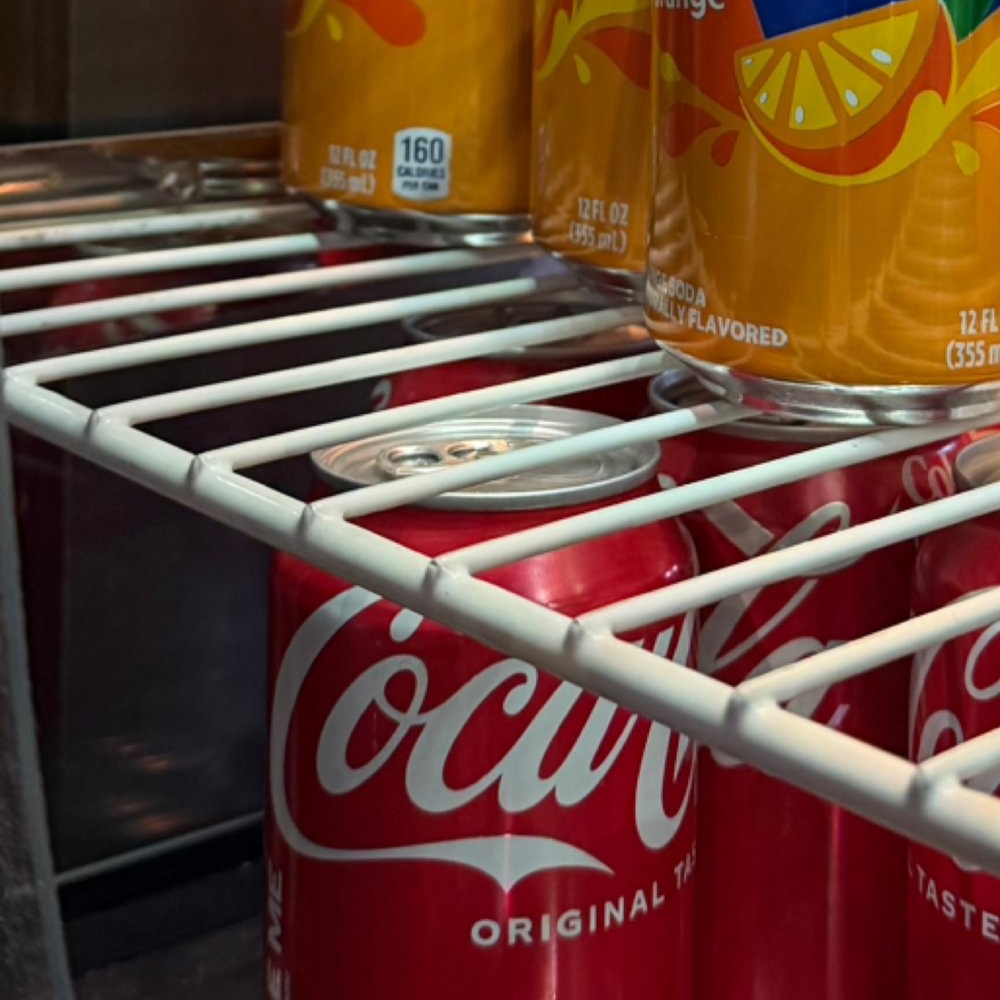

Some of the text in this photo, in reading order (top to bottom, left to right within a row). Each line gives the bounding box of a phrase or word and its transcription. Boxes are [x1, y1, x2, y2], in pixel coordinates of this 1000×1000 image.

[358, 149, 378, 170] OZ
[401, 136, 445, 165] 160
[397, 165, 446, 180] CALORIES
[578, 196, 630, 226] 12 FL OZ
[687, 307, 790, 347] FLAVORED
[959, 309, 978, 336] 12
[980, 307, 1000, 334] FL
[945, 339, 987, 371] (355
[469, 880, 666, 948] ORIGINAL
[915, 868, 1000, 944] TASTE
